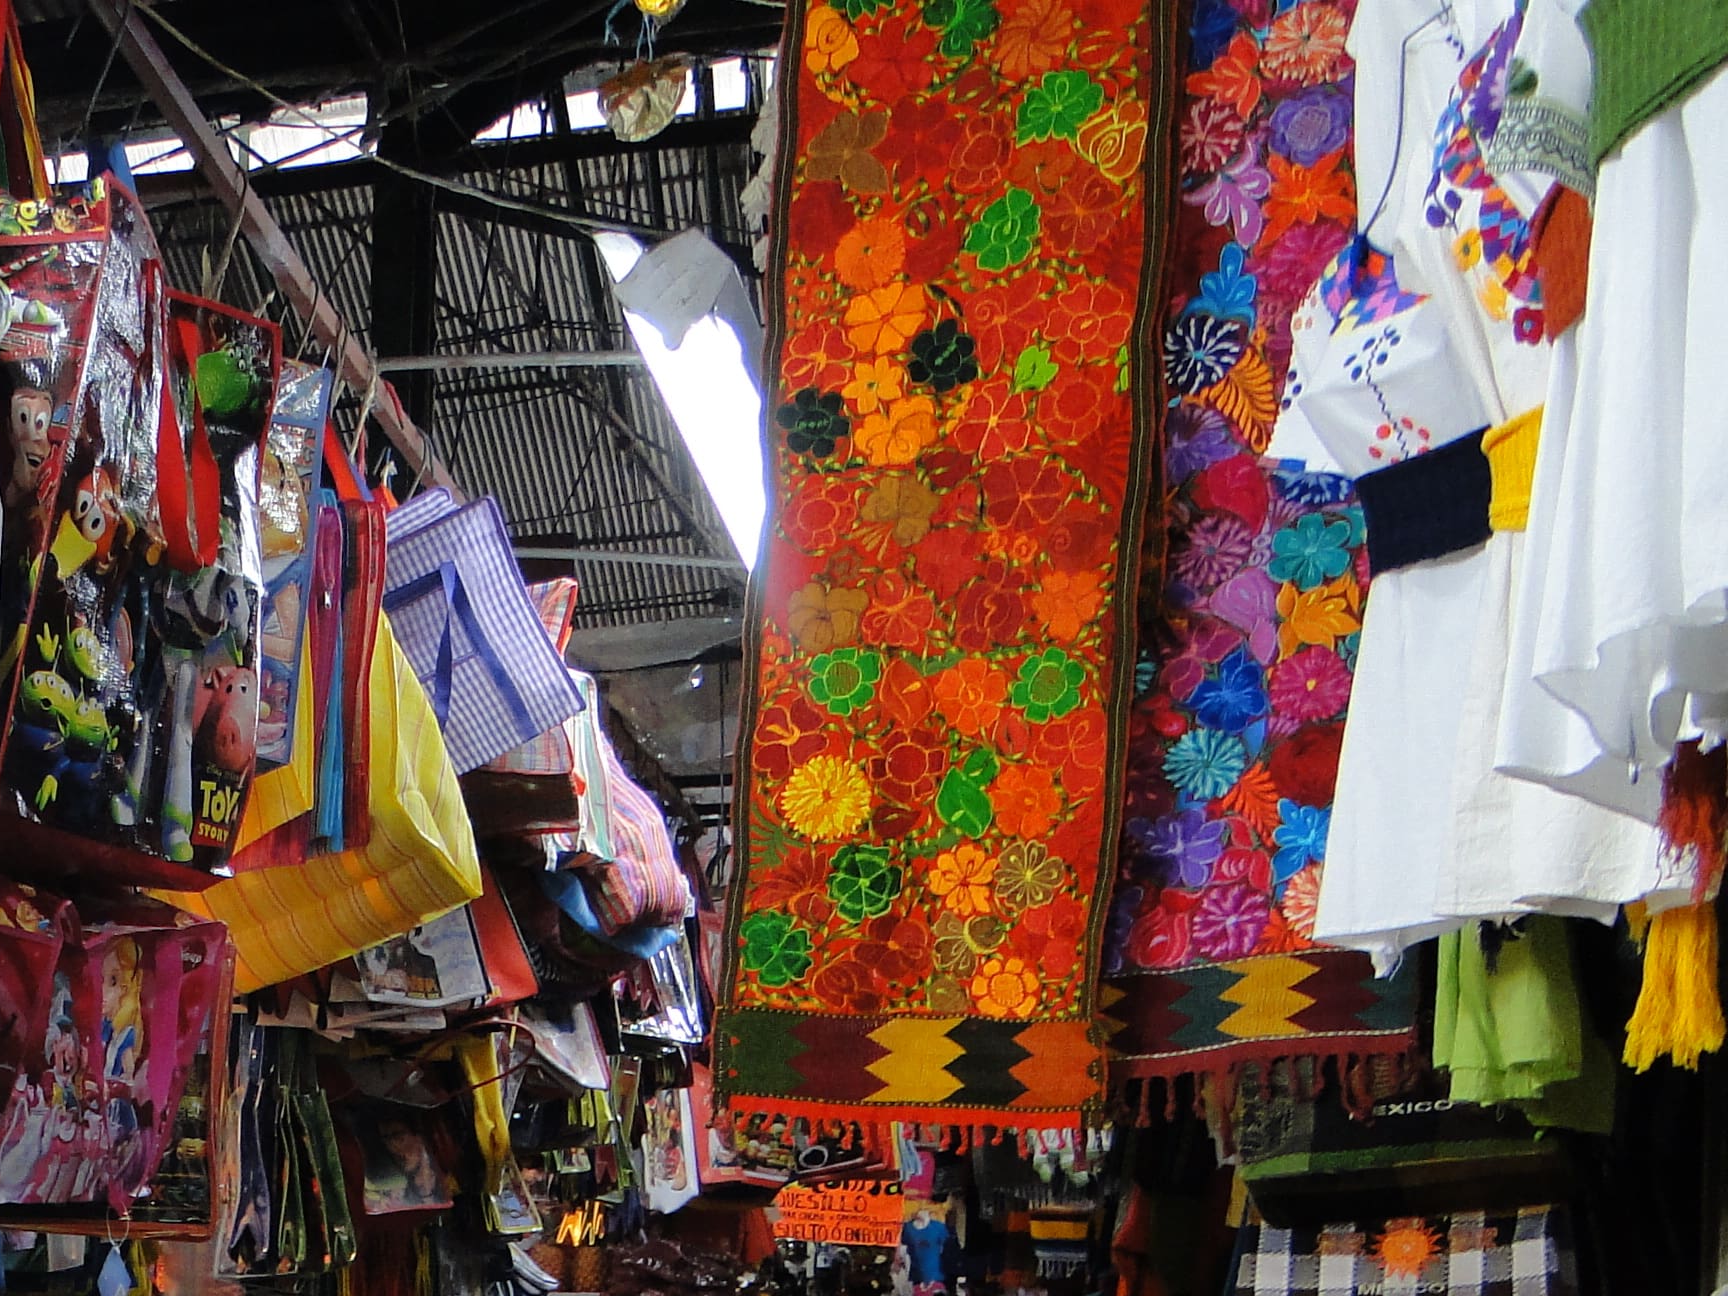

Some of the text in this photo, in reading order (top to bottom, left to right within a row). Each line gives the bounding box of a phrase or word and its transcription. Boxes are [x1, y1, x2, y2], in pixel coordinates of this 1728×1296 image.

[200, 780, 240, 824] TOY
[198, 822, 229, 842] STORY
[1372, 1099, 1453, 1117] EXICO
